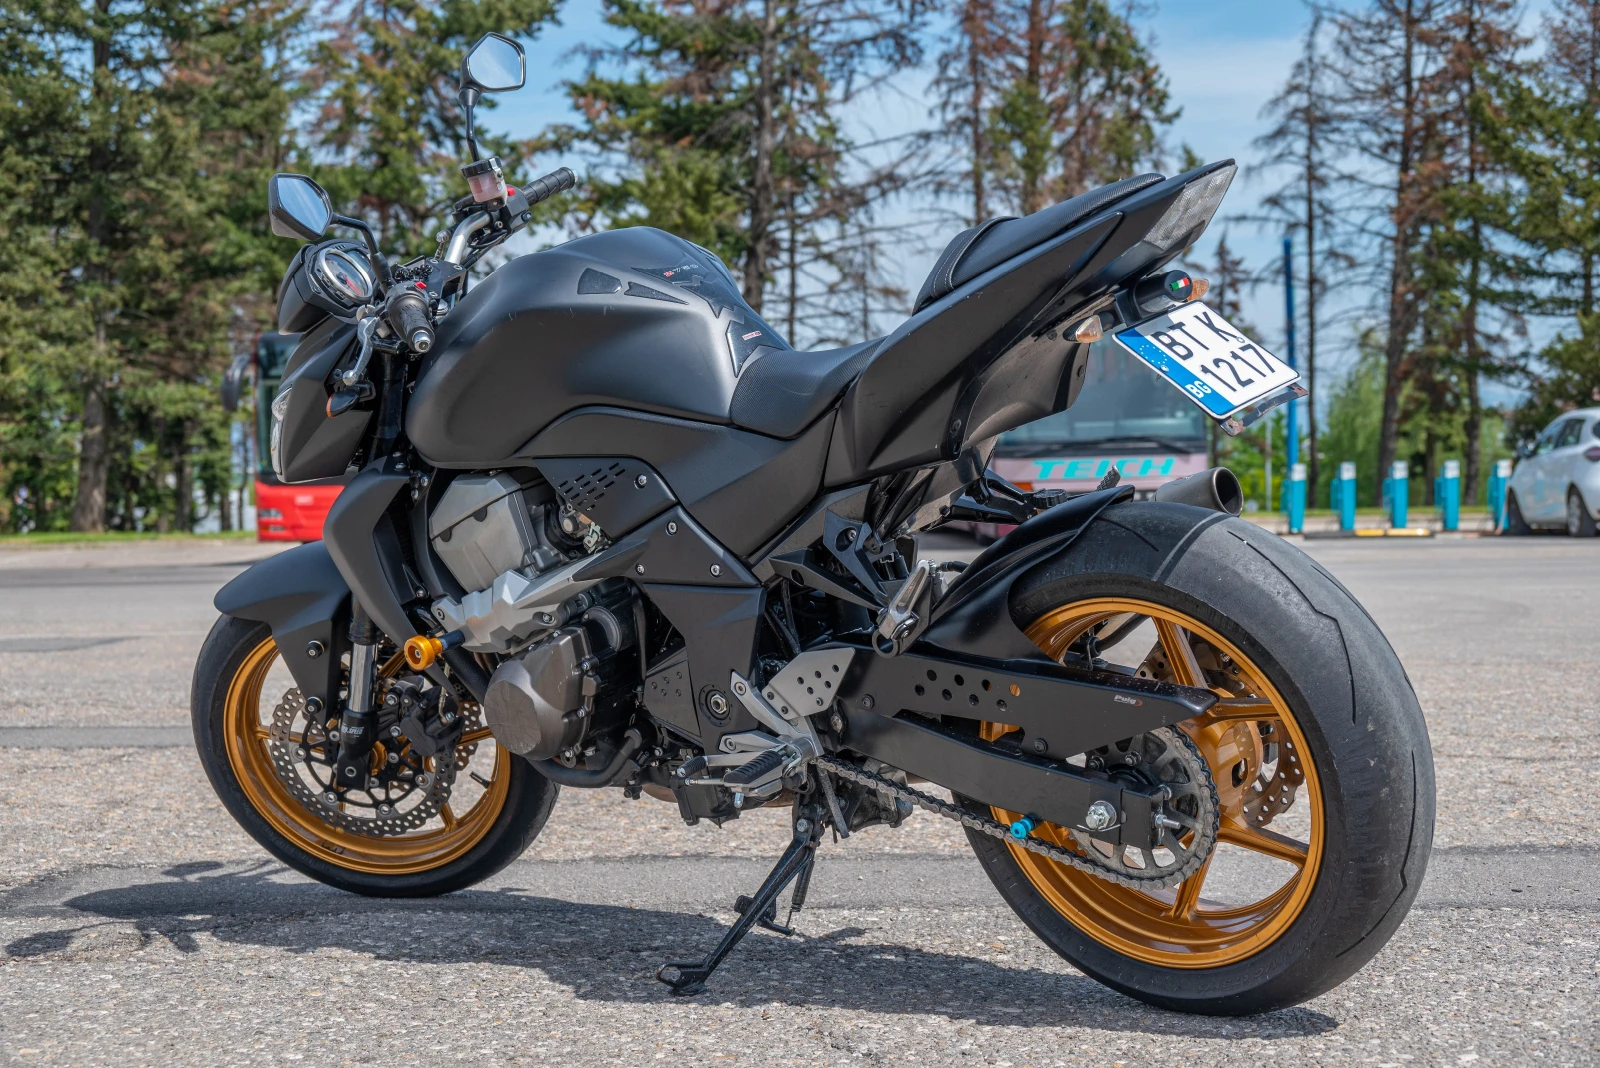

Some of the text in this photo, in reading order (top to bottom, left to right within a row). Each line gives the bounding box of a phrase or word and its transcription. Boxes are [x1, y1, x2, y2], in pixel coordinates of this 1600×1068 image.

[1151, 311, 1238, 361] BT K
[1200, 343, 1276, 392] 1217
[1184, 380, 1212, 398] BG
[1033, 457, 1176, 480] TEICH
